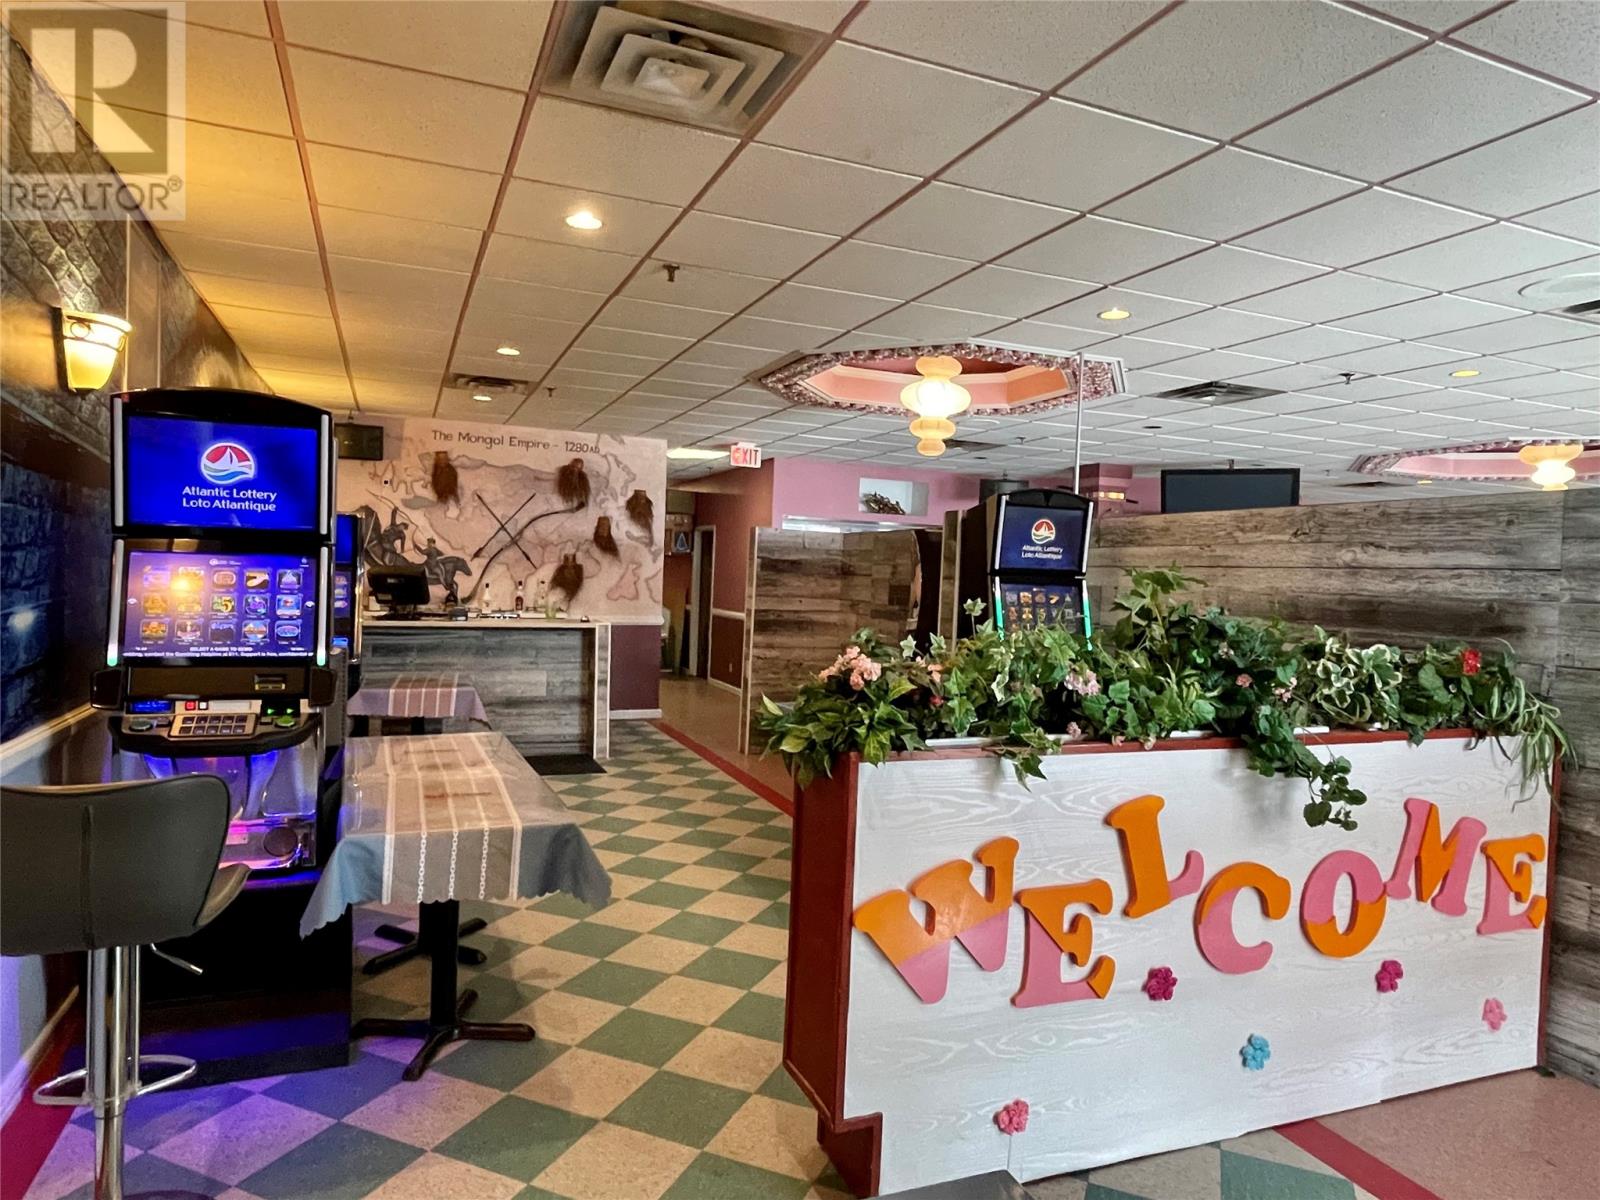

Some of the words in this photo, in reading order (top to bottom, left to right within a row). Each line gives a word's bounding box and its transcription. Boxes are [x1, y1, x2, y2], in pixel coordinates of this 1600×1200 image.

[432, 430, 453, 441] The
[458, 432, 504, 449] Mongol
[509, 436, 550, 451] Empire
[733, 447, 759, 466] EXIT
[182, 486, 230, 498] Atlantic
[233, 488, 277, 502] Lottery
[182, 497, 211, 508] Loto
[212, 500, 276, 513] Atlantique
[852, 795, 1546, 1008] WELCOME
